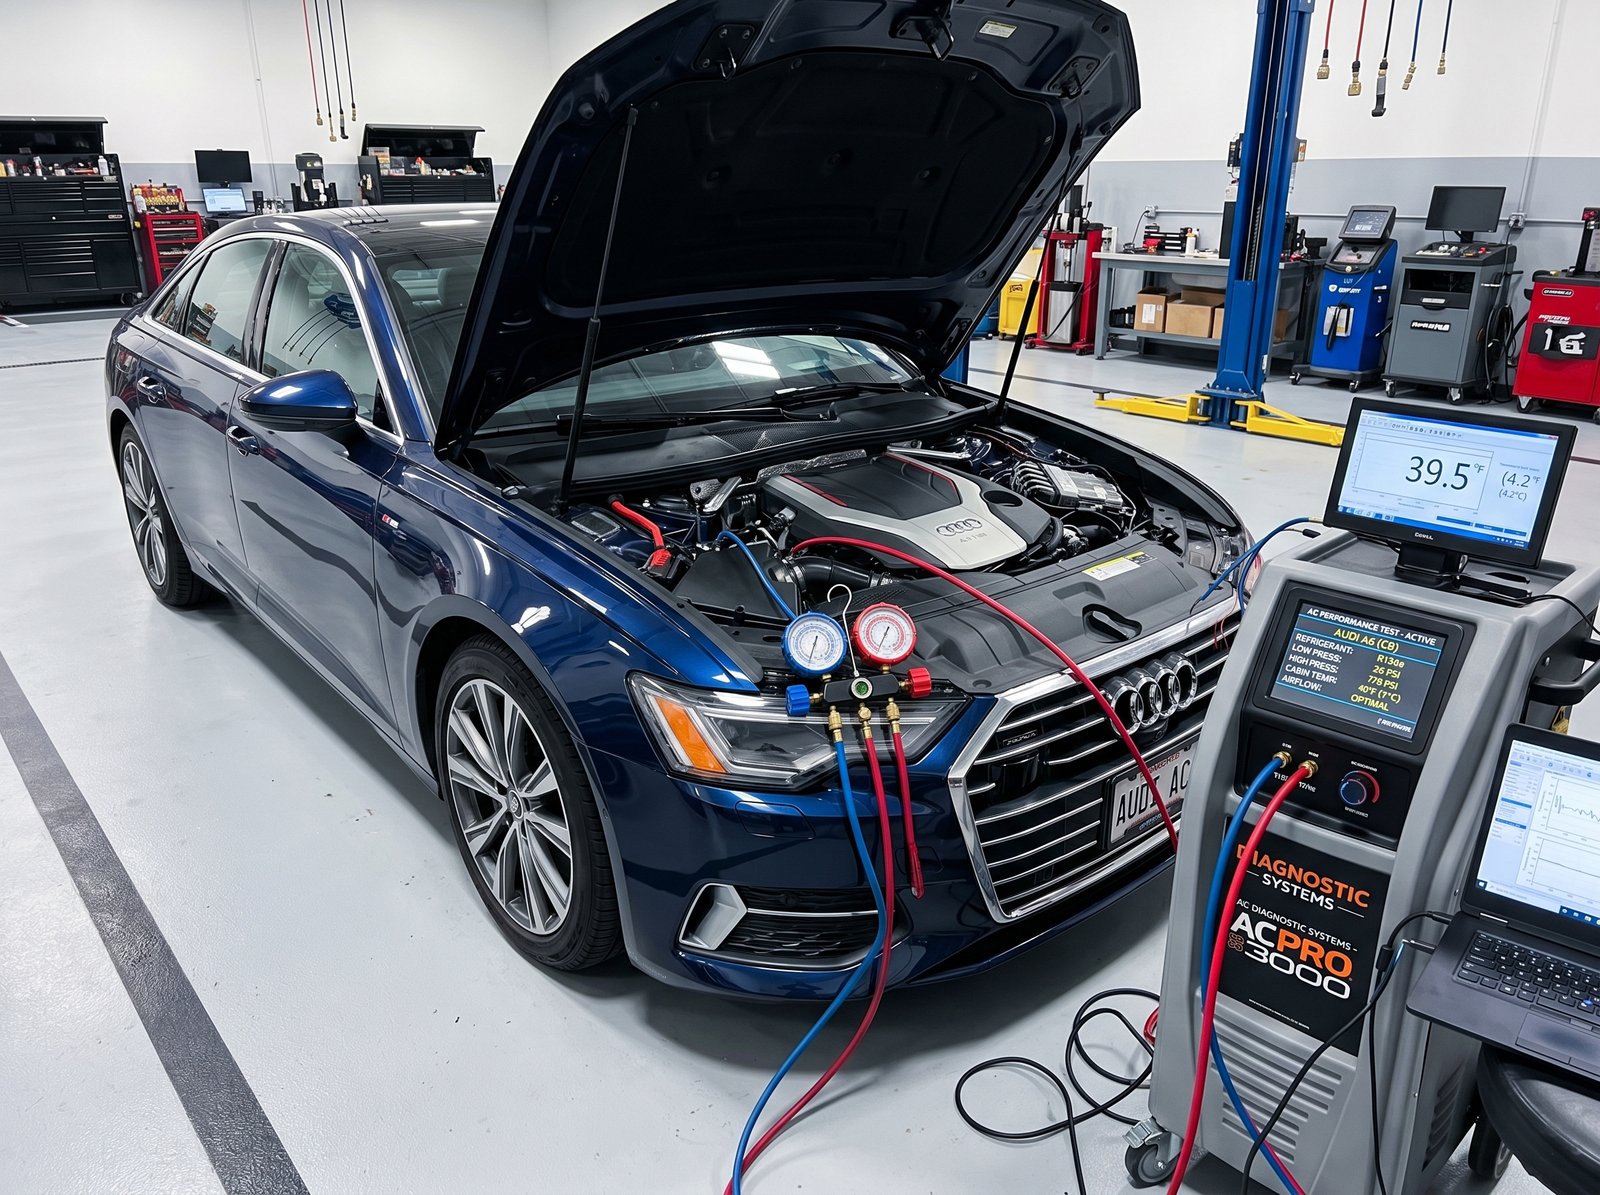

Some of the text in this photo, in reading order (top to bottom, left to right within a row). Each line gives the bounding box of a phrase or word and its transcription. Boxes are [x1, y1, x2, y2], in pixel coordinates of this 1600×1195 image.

[1296, 633, 1354, 654] REFRIGERANT:
[1307, 608, 1319, 616] AC
[1320, 611, 1379, 631] PERFORMANCE
[1380, 626, 1400, 636] TEST
[1405, 632, 1436, 646] ACTIVE
[1334, 629, 1360, 642] AUDI
[1361, 636, 1376, 646] A6
[1285, 664, 1310, 677] CABIN
[1289, 654, 1309, 665] HIGH
[1309, 659, 1339, 673] PRESS:
[1384, 680, 1399, 690] PSI
[1292, 644, 1401, 679] LOW PRESS: 26 PSI
[1281, 675, 1389, 712] AIRFLOW: OPTIMAL
[1262, 873, 1335, 911] SYSTEMS
[1251, 904, 1307, 933] DIAGNOSTIC
[1308, 928, 1352, 951] SYSTEMS
[1244, 940, 1351, 999] 3000
